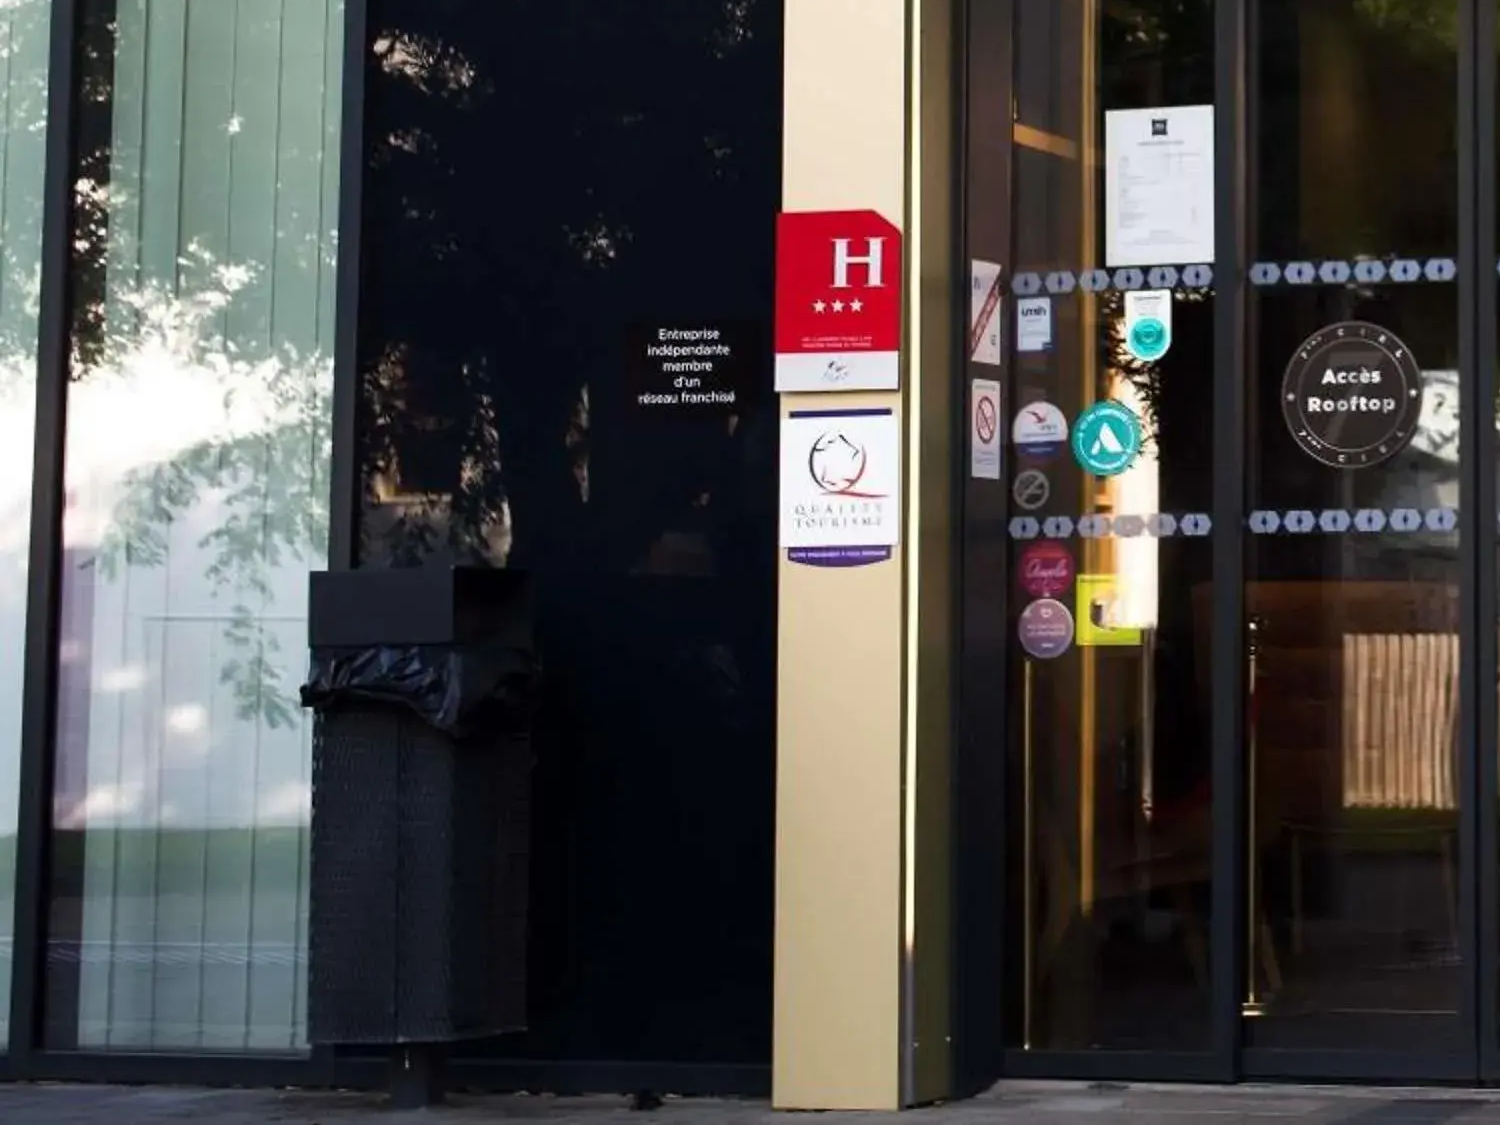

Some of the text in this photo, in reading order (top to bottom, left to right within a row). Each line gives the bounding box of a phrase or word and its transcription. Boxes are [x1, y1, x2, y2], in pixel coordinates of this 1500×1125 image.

[831, 236, 888, 288] H
[658, 328, 720, 342] Entreprise
[647, 344, 731, 358] indépendante
[663, 360, 713, 372] membre
[674, 376, 701, 388] d'un
[1321, 367, 1382, 384] Accès
[1307, 395, 1396, 414] Rooftop
